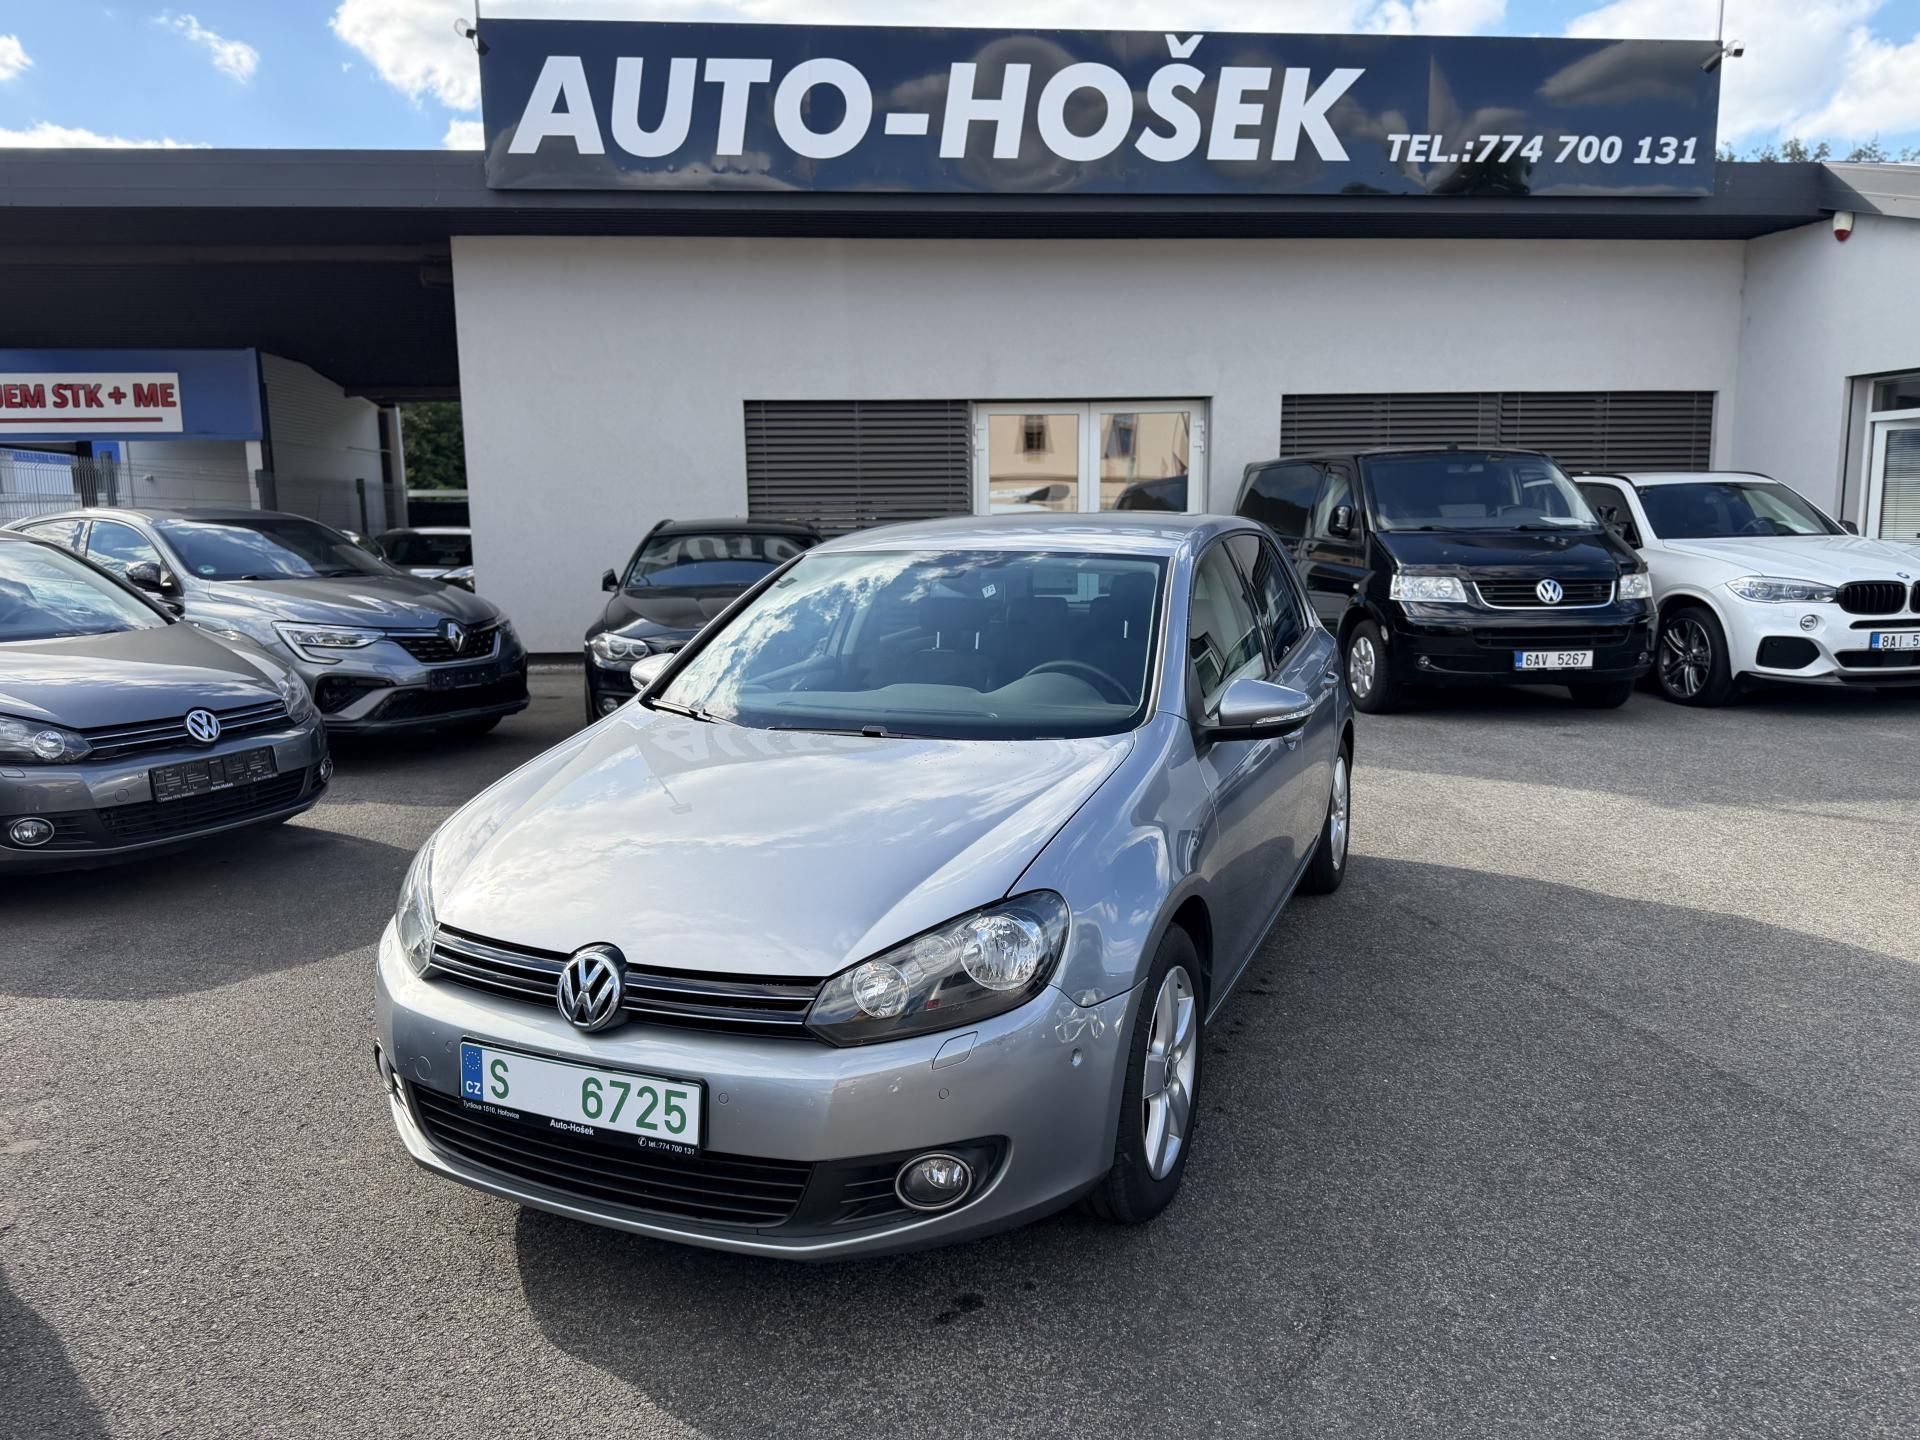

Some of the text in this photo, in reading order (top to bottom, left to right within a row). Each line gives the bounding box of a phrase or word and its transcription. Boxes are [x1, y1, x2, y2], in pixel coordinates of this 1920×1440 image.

[507, 34, 1366, 162] AUTO-HOŠEK
[1387, 134, 1697, 165] TEL.:774 700 131
[0, 384, 46, 408] EM
[52, 383, 104, 409] STK
[133, 383, 177, 408] ME
[1882, 635, 1903, 648] 8AI
[1525, 652, 1587, 666] 6AV 5267
[465, 1080, 482, 1095] CZ
[490, 1058, 688, 1134] S 6725
[549, 1119, 595, 1136] Auto-Hošek
[671, 1144, 683, 1153] 700
[684, 1147, 695, 1155] 131
